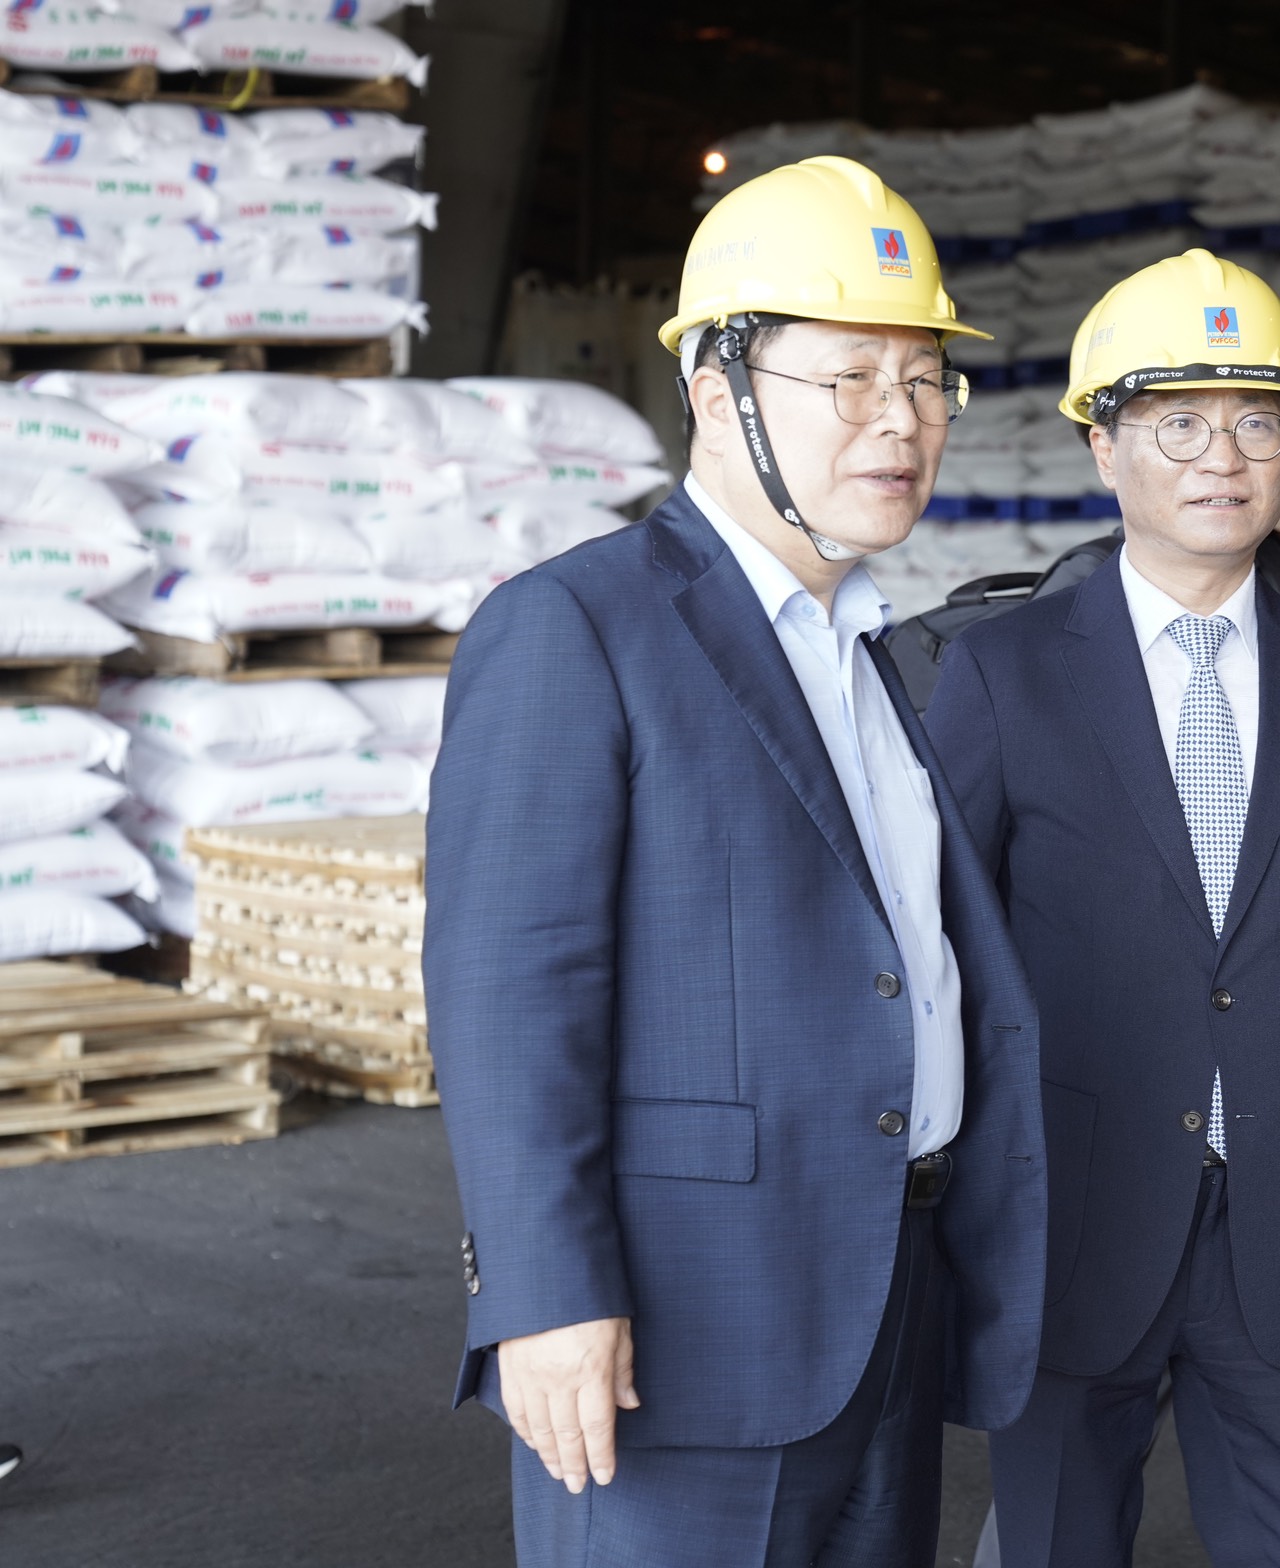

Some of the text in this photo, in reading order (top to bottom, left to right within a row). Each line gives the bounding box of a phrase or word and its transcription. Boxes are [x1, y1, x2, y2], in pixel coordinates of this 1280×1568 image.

[881, 264, 910, 274] PVFCCo
[1139, 371, 1185, 381] Protector
[1233, 368, 1277, 377] Protector
[745, 417, 771, 475] Protector
